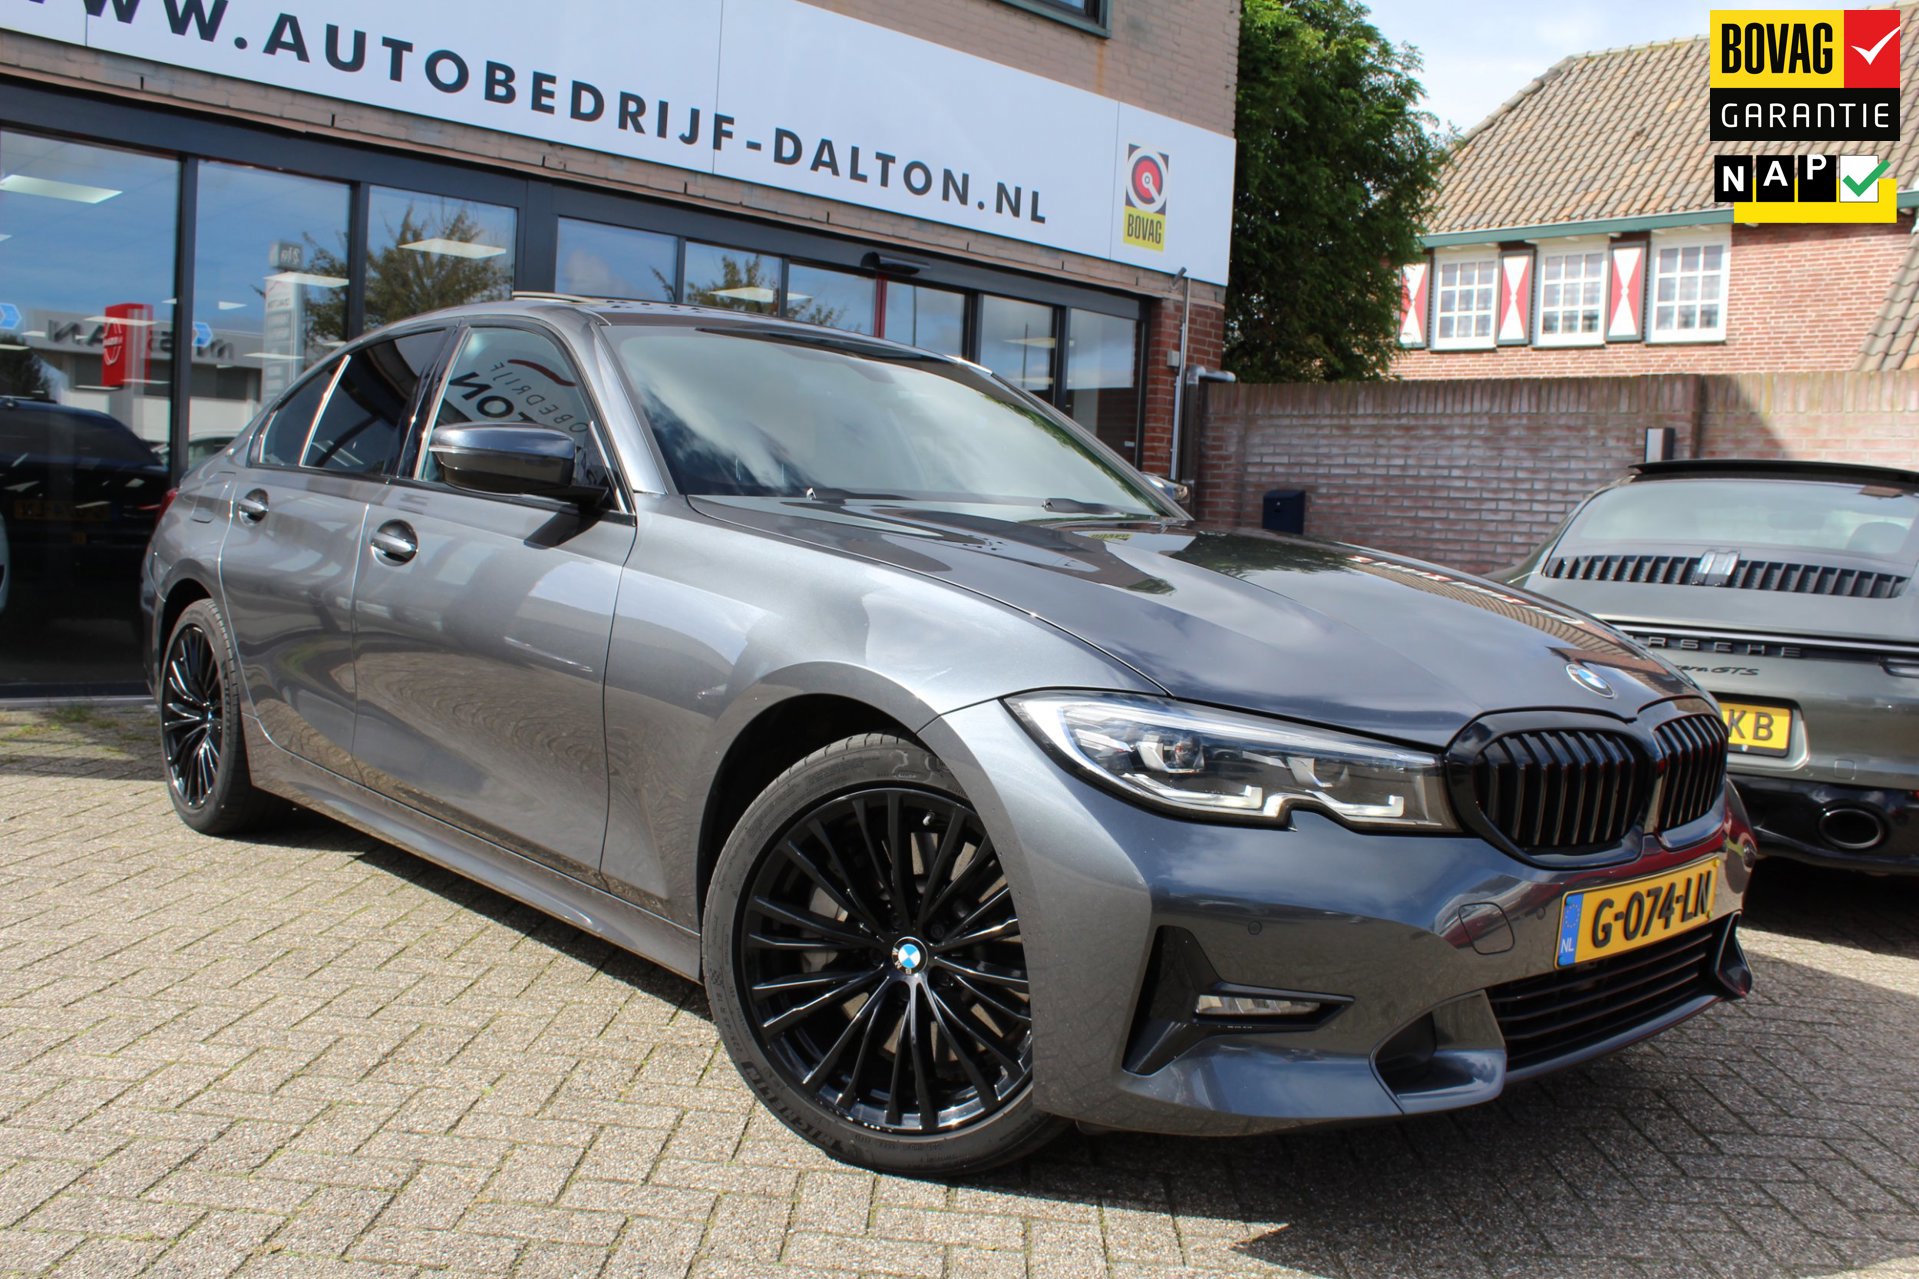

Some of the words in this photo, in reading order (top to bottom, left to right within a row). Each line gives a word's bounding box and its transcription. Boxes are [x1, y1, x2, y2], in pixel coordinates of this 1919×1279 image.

[28, 0, 1046, 224] W.AUTOBEDRIJF-DALTON.NL
[1127, 213, 1162, 244] BOVAG
[1646, 635, 1801, 658] RSCHE
[1592, 870, 1712, 948] G-074-LN
[1560, 938, 1574, 953] NL
